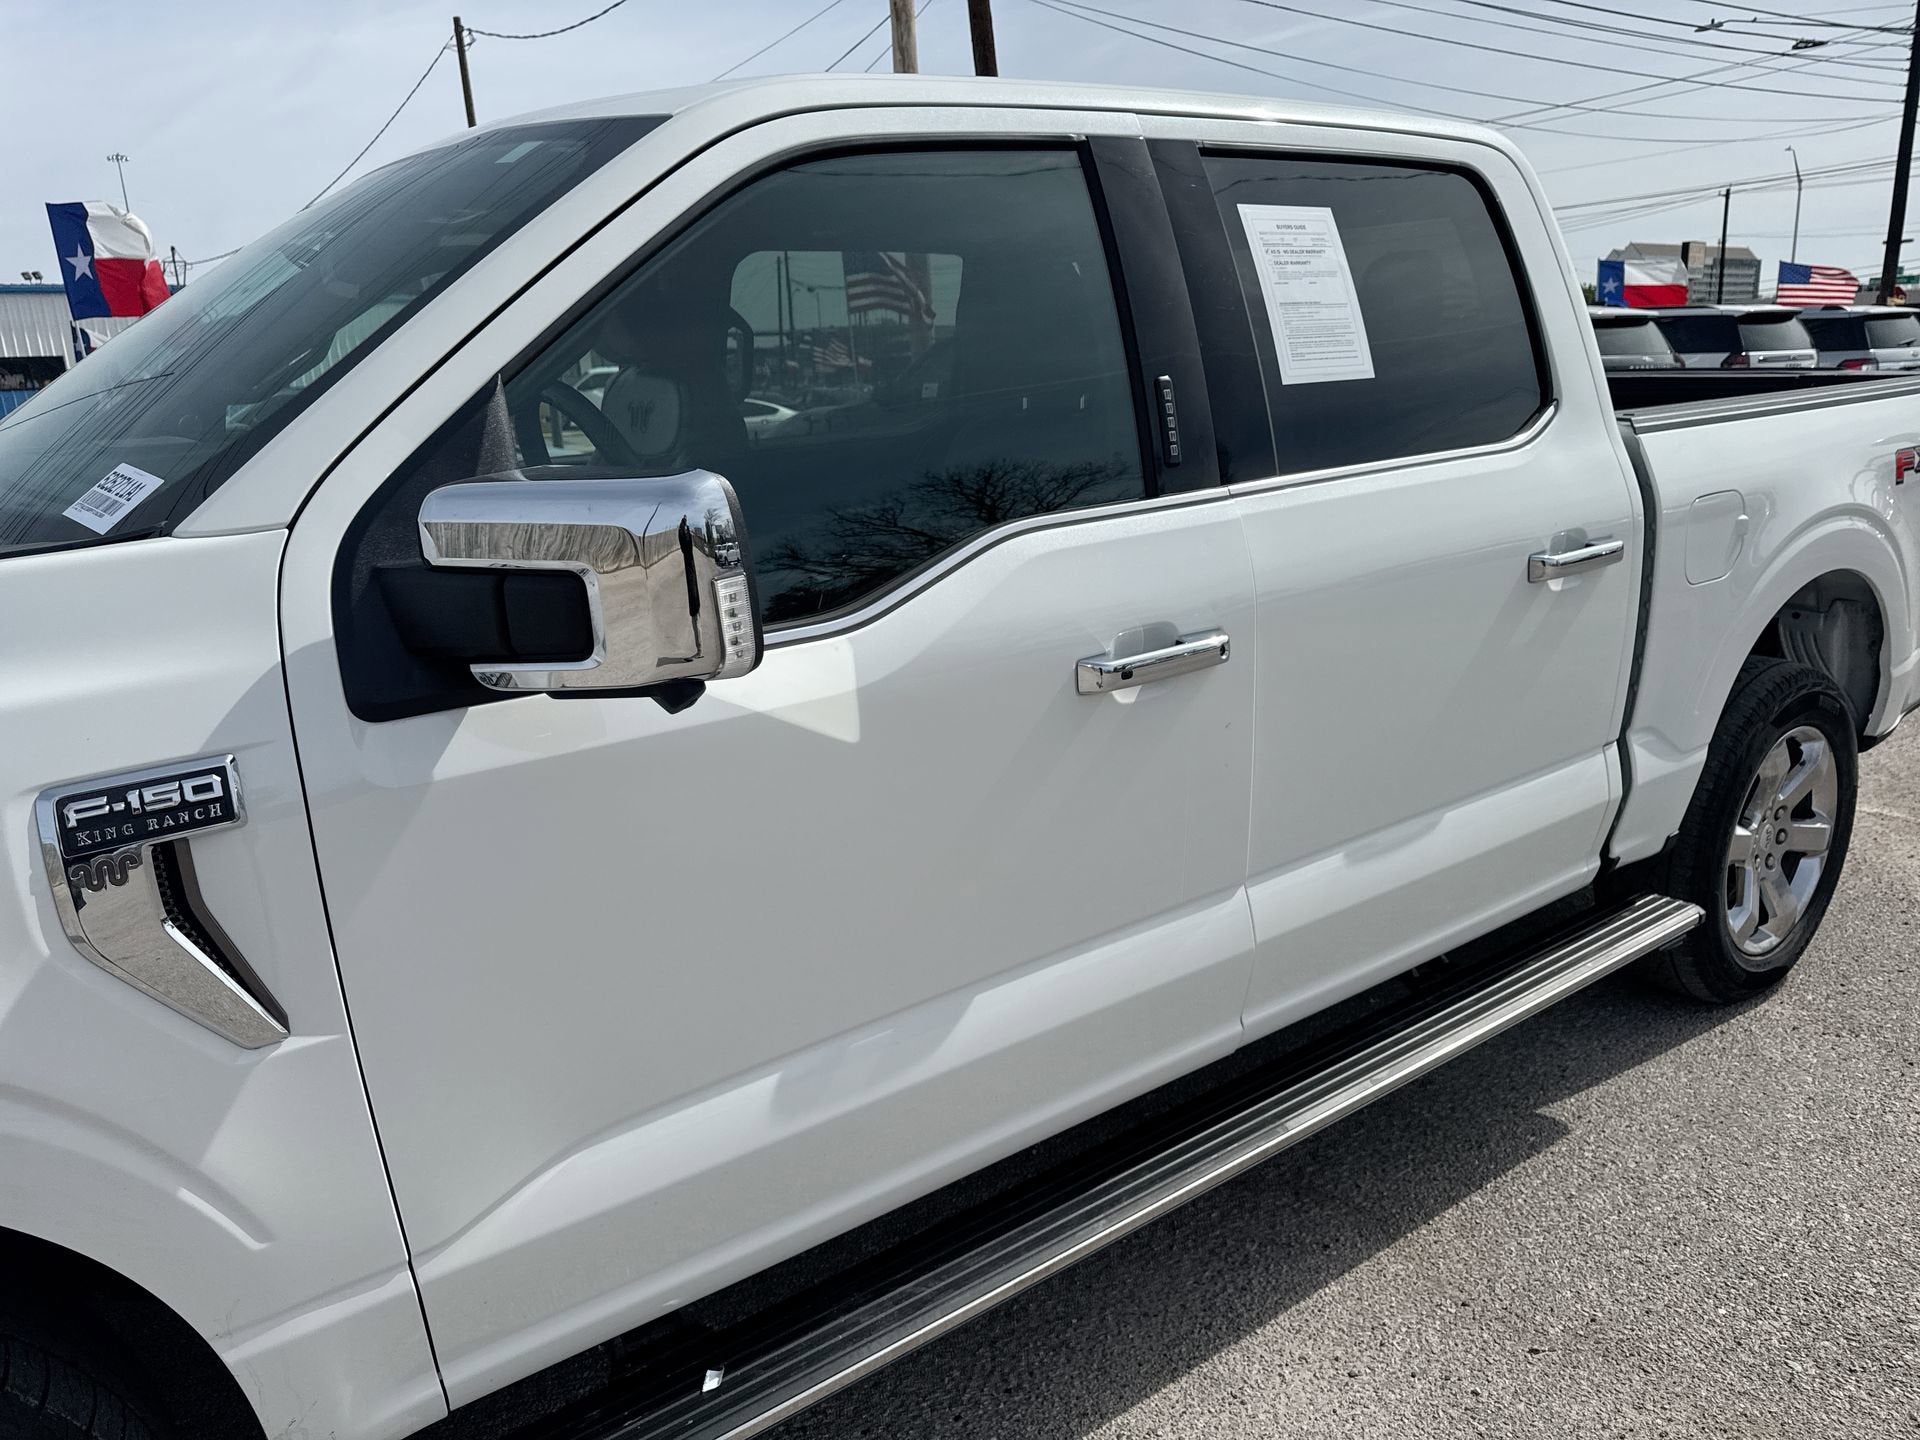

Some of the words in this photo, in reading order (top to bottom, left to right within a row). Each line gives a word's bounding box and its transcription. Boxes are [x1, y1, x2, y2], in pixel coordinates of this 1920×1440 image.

[62, 774, 224, 828] F-150
[76, 823, 135, 847] KING
[147, 803, 223, 831] RANCH
